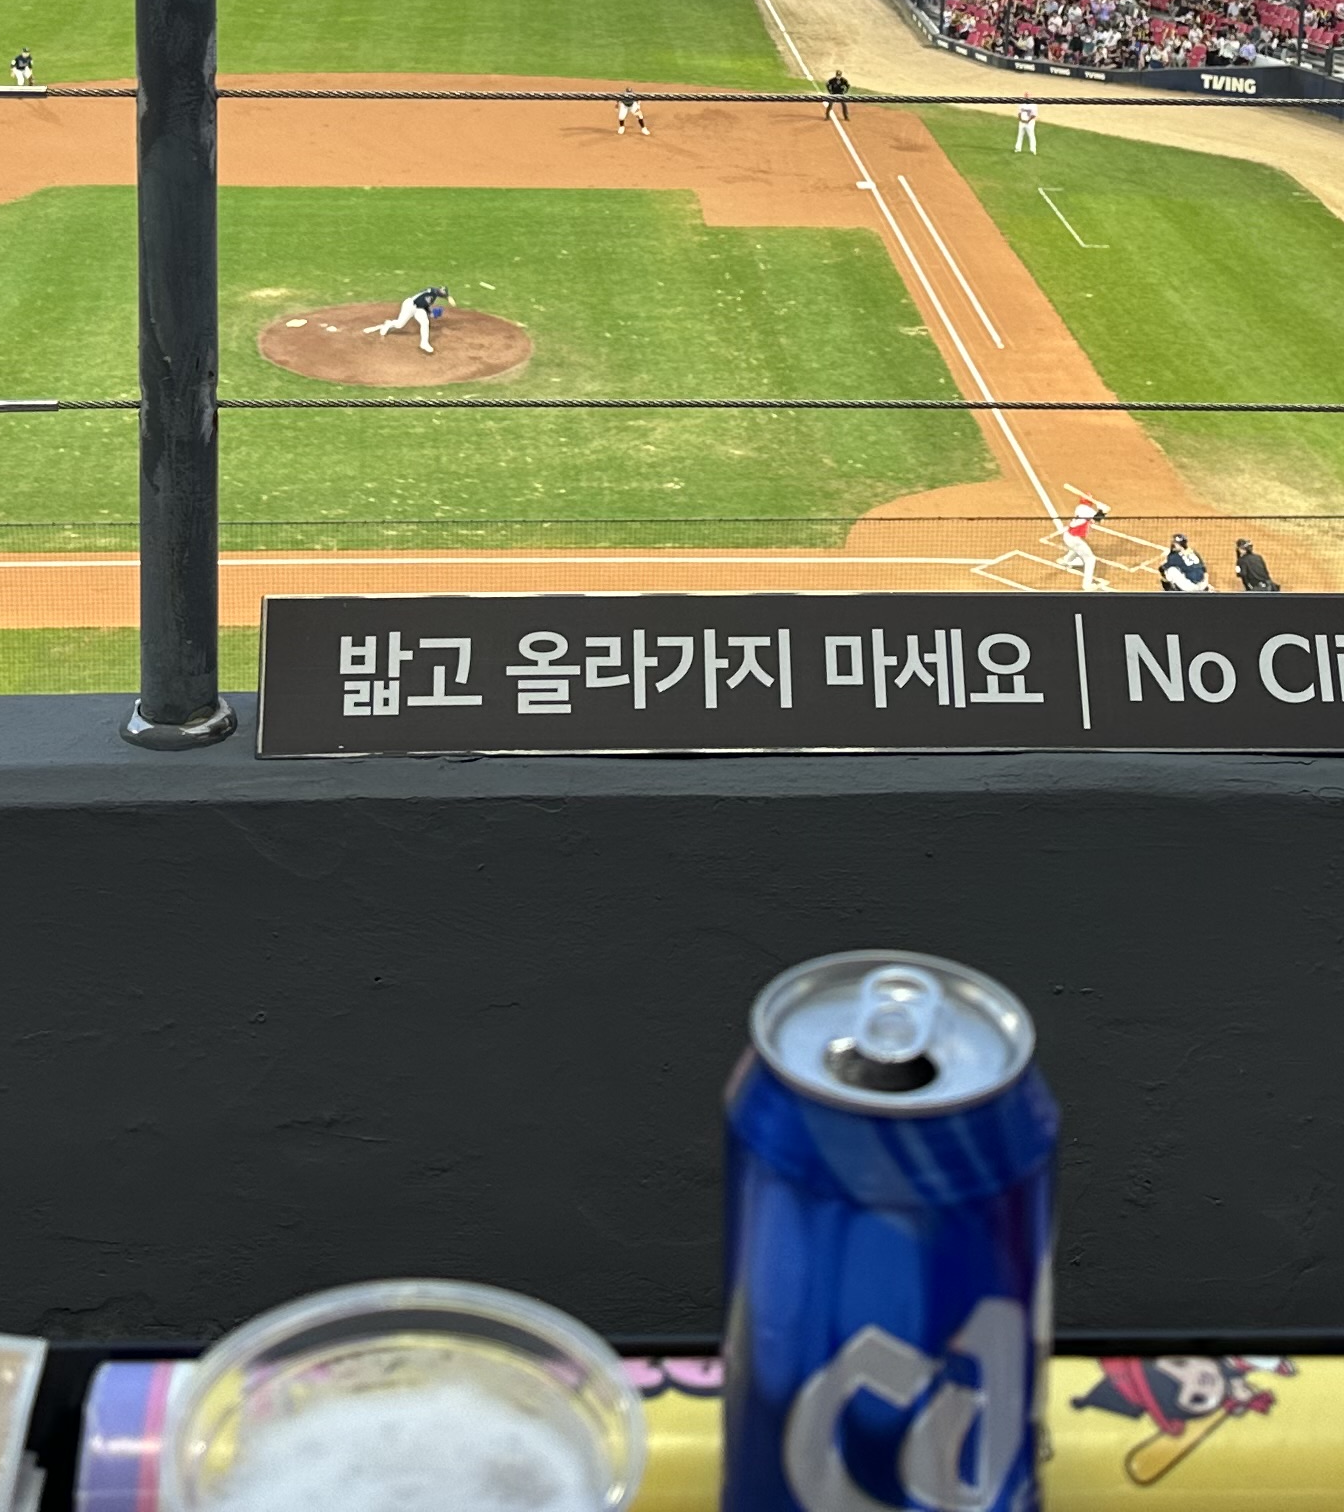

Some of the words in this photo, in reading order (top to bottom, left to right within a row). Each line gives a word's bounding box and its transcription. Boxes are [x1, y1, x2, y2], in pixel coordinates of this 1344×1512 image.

[1201, 74, 1257, 94] TVING
[339, 631, 483, 717] 밟고
[505, 628, 794, 715] 올라가지
[822, 628, 1046, 710] 마세요
[1125, 634, 1238, 703] No
